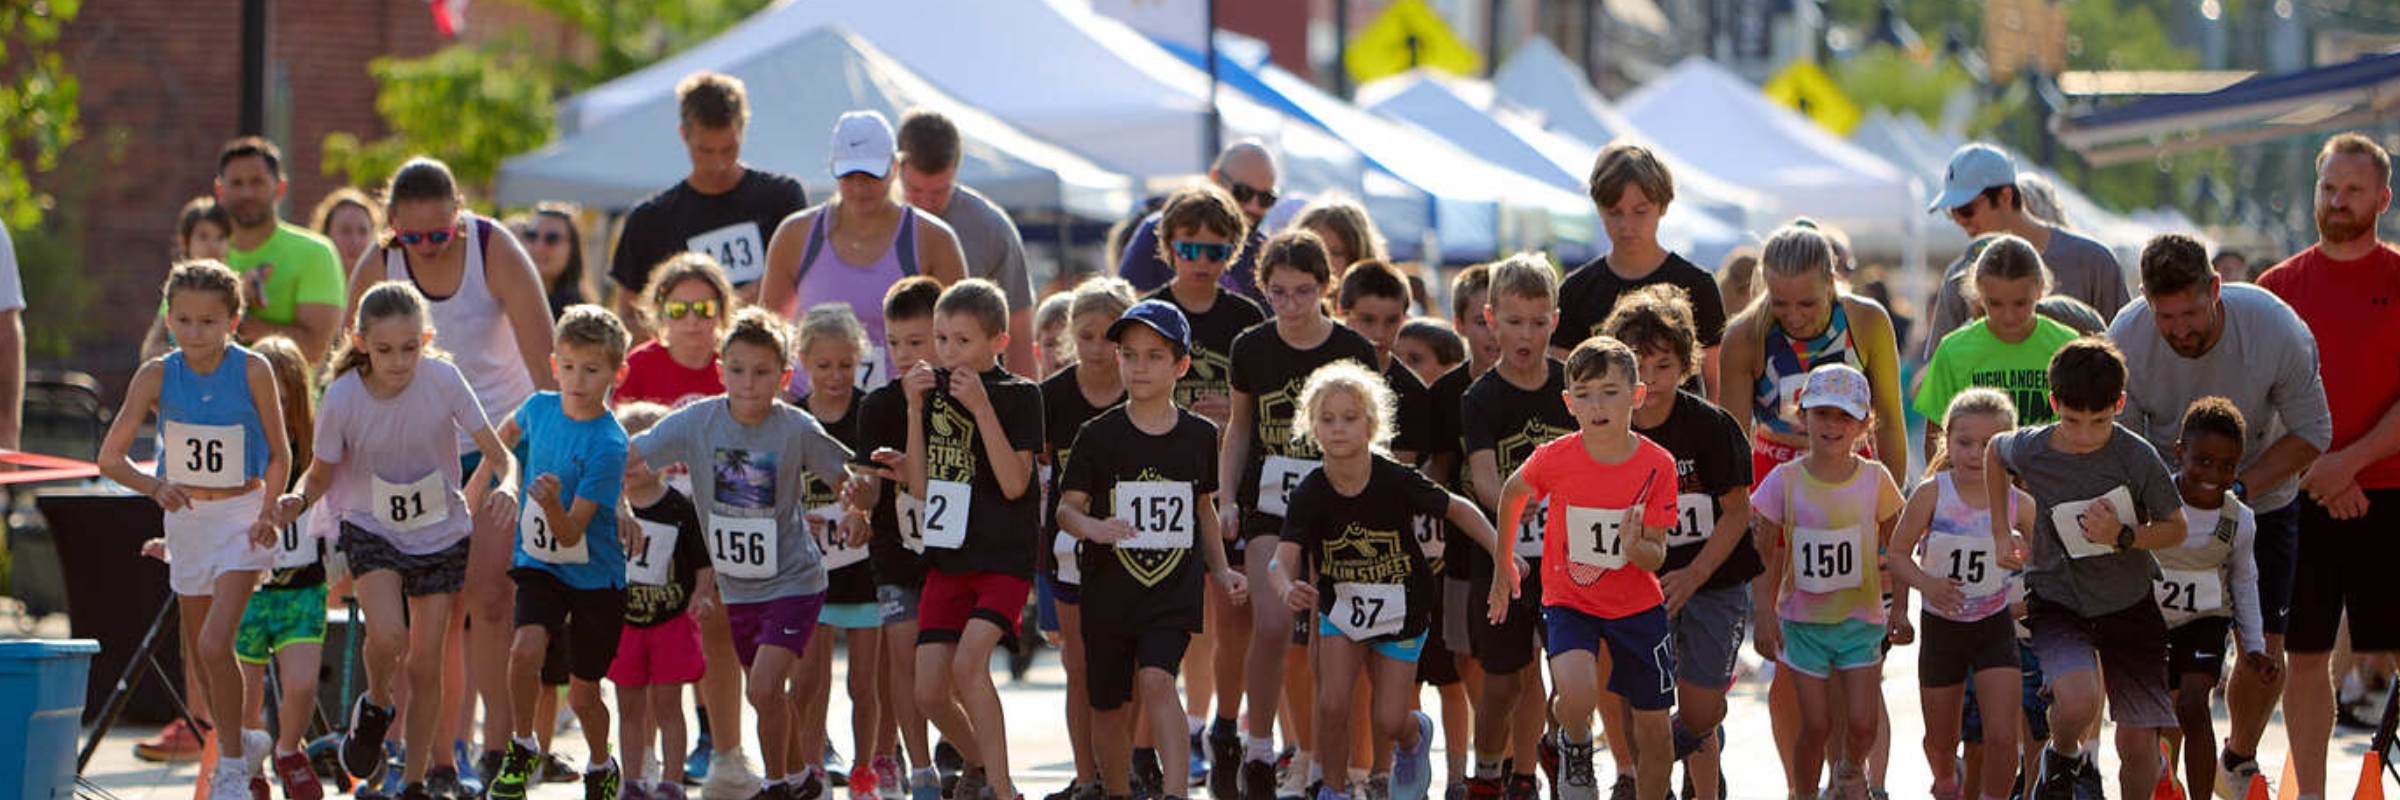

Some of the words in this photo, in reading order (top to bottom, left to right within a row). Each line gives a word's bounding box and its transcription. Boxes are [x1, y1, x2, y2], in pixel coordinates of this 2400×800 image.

[705, 236, 753, 270] 43
[861, 362, 875, 385] 7
[186, 437, 224, 473] 36
[389, 491, 427, 522] 81
[926, 495, 947, 531] 2
[1131, 496, 1184, 533] 152
[714, 528, 765, 566] 156
[1801, 540, 1853, 579] 150
[1948, 548, 1987, 583] 15
[1350, 595, 1386, 629] 67
[2162, 581, 2198, 613] 21
